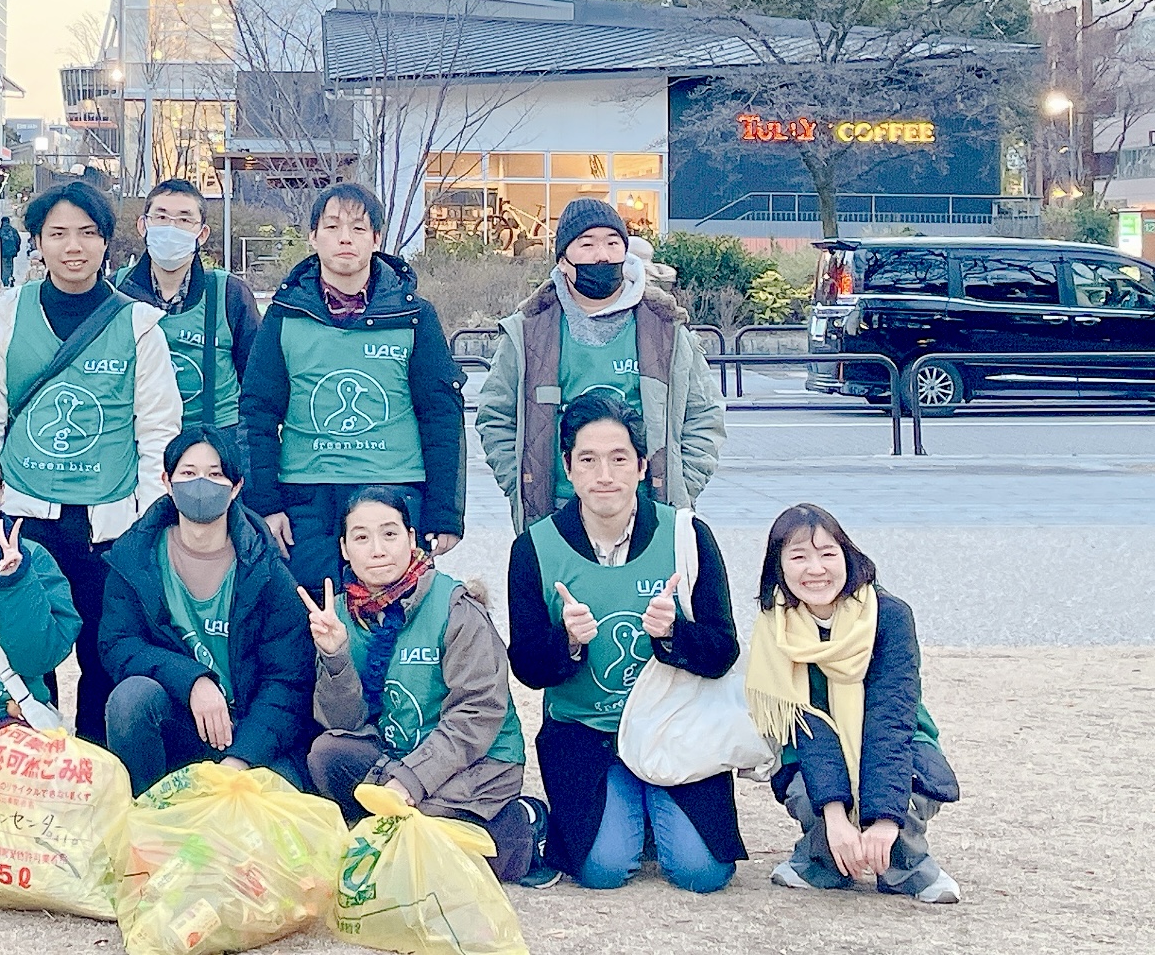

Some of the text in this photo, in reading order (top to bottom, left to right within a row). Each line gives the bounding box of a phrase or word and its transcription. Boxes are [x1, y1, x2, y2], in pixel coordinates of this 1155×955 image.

[836, 121, 936, 142] COFFEE
[365, 344, 407, 360] UACJ
[84, 360, 128, 374] UACJ
[356, 440, 387, 451] bird
[22, 457, 101, 473] green bird
